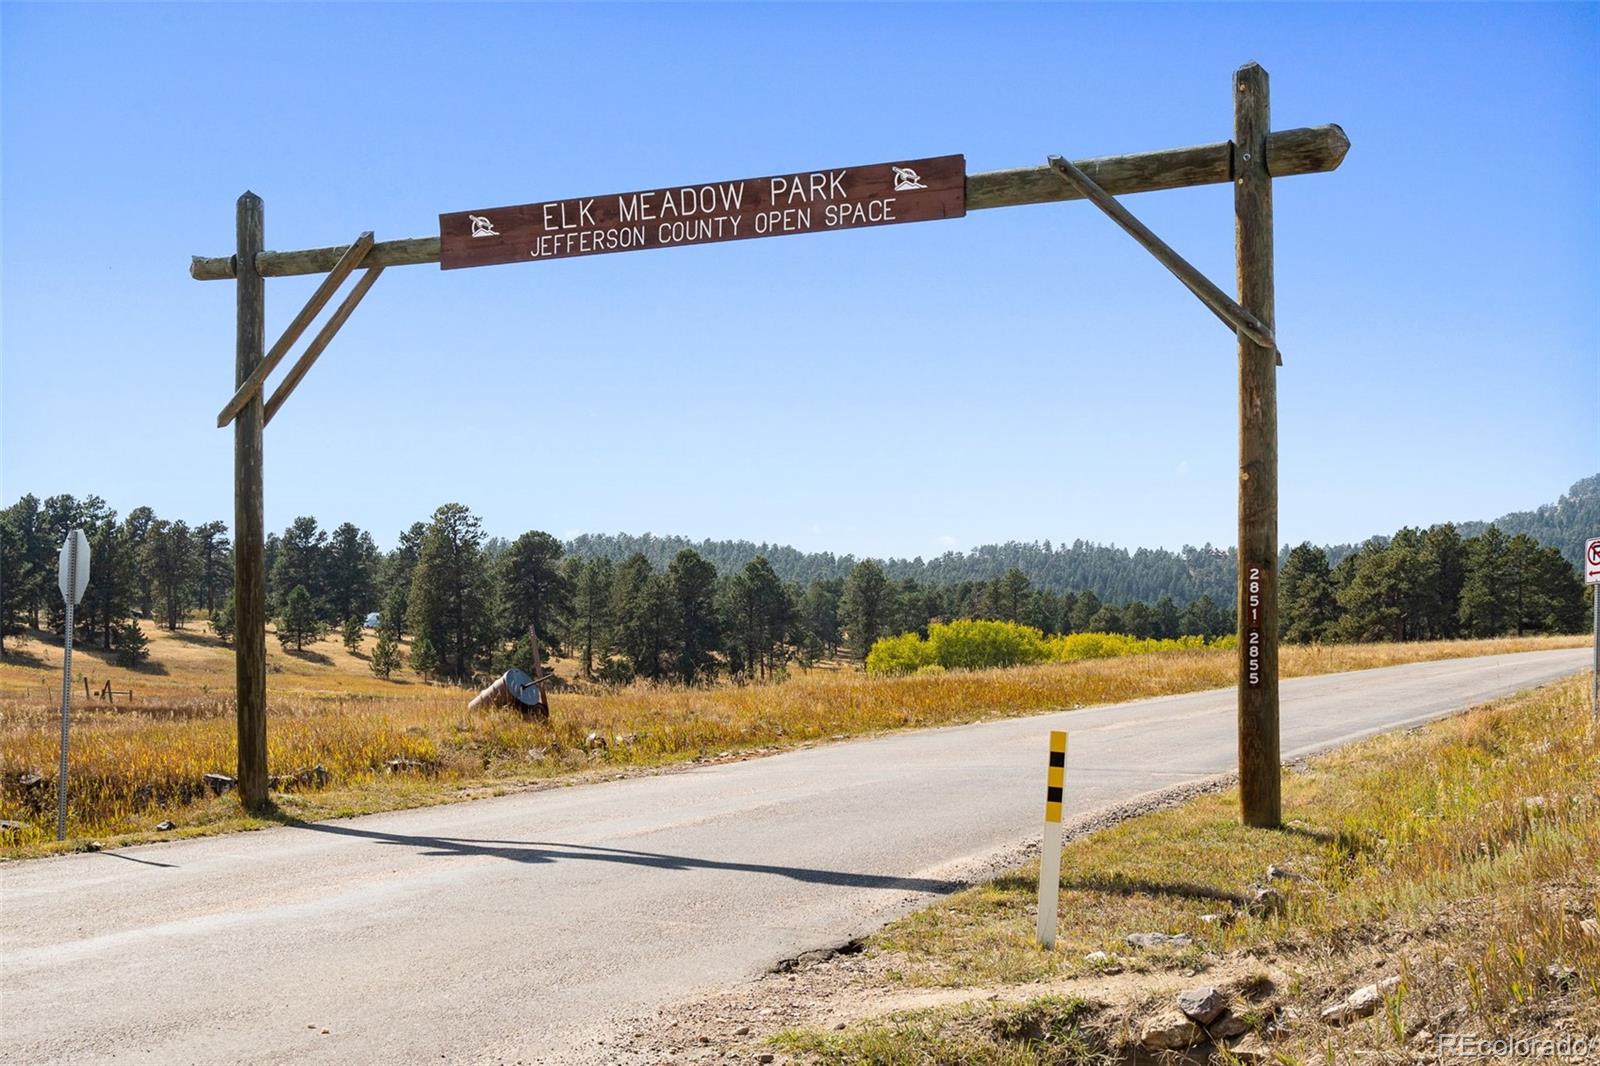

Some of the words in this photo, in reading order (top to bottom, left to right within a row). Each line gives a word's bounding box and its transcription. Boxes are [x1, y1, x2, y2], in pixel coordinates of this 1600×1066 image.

[530, 225, 645, 257] JEFFERSON
[658, 214, 743, 244] COUNTY
[754, 207, 811, 234] OPEN
[825, 198, 897, 226] SPACE
[543, 200, 597, 231] ELK
[618, 184, 745, 223] MEADOW
[770, 172, 848, 206] PARK
[1249, 567, 1260, 620] 2851
[1248, 632, 1260, 685] 2855
